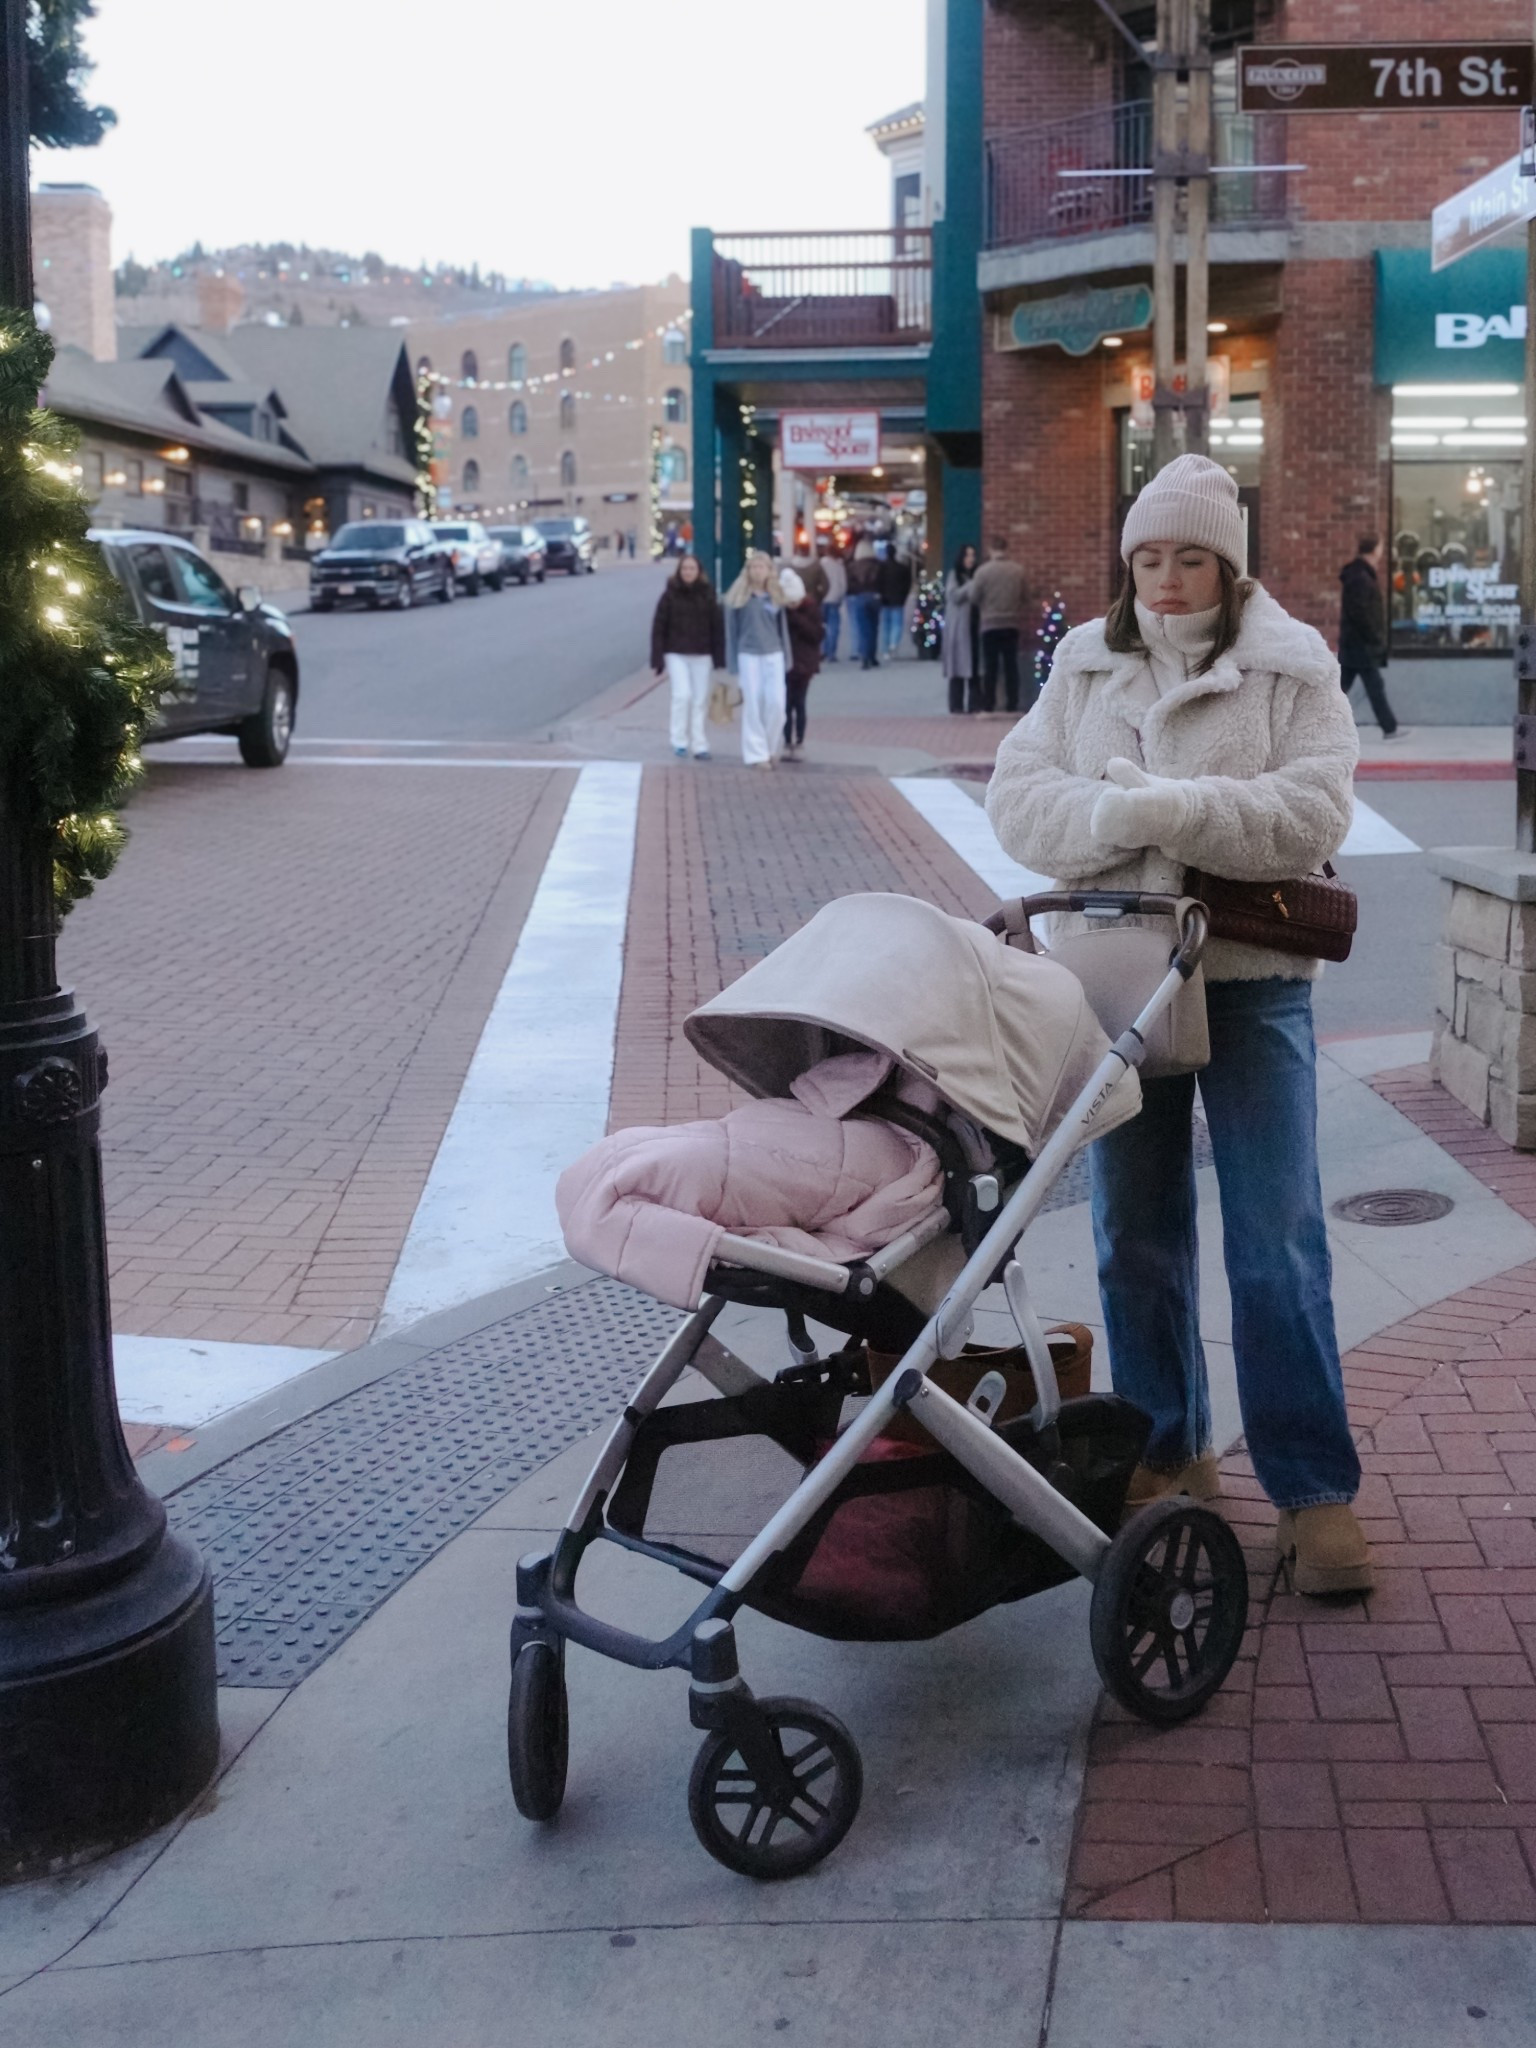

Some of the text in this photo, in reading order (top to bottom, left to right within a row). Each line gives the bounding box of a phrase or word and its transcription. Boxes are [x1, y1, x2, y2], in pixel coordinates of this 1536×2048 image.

[1370, 58, 1442, 97] 7th
[1469, 187, 1507, 235] Main
[1081, 1082, 1114, 1126] VISTA
